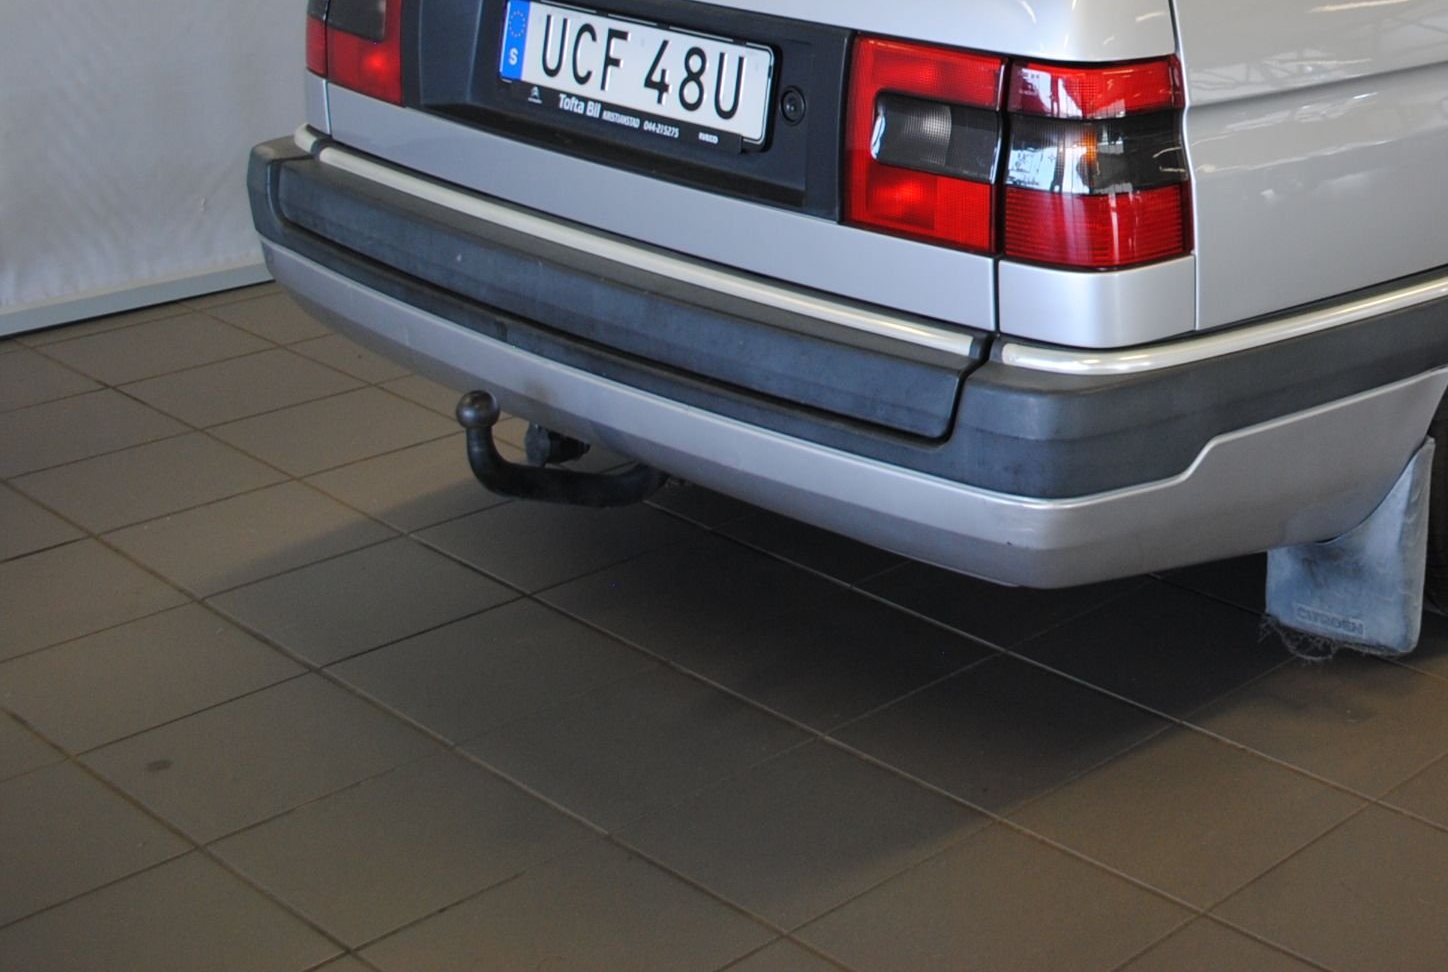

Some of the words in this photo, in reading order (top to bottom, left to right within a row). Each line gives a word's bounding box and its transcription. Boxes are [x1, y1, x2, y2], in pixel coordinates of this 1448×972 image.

[508, 48, 518, 65] S
[542, 14, 631, 91] UCF
[644, 39, 745, 120] 48U
[558, 94, 584, 114] Tofta
[586, 100, 601, 118] Bil
